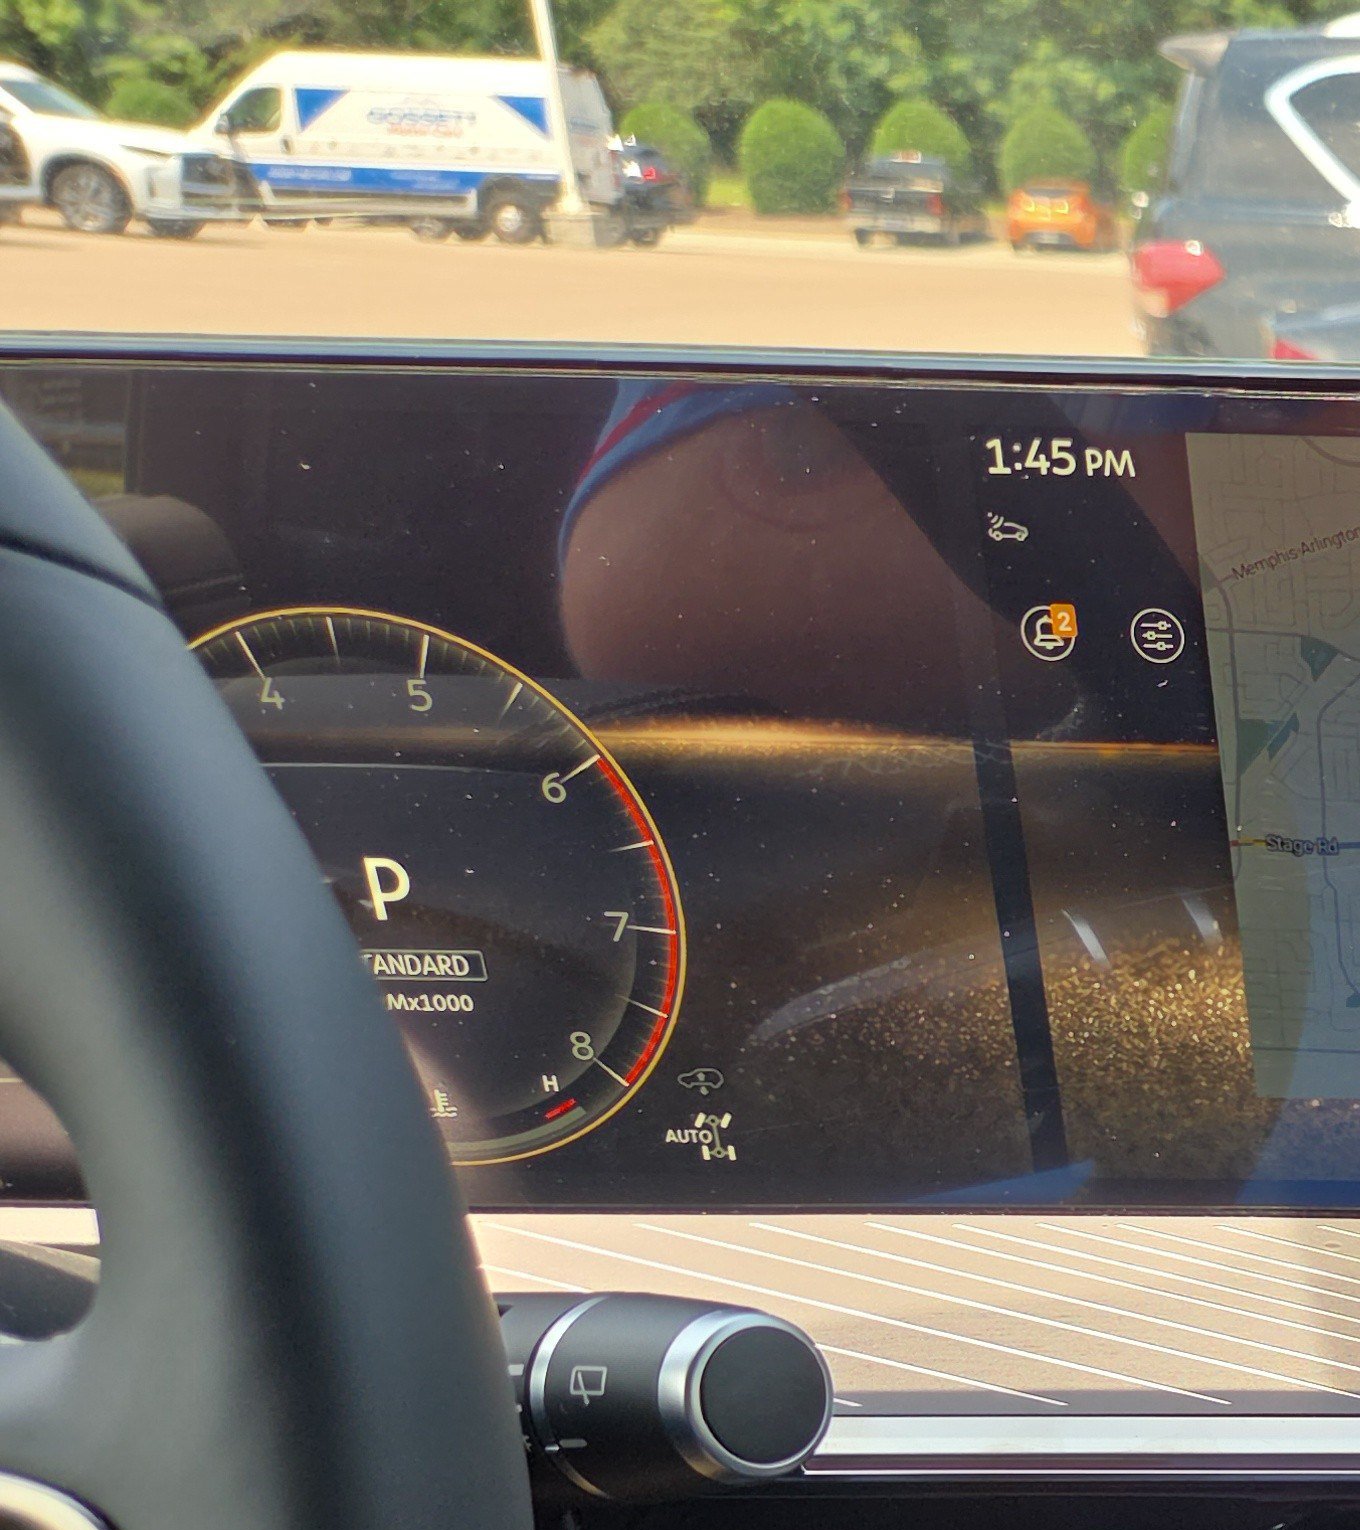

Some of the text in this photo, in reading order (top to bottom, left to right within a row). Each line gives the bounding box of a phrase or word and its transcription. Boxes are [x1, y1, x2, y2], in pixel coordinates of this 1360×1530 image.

[985, 437, 1136, 478] 1:45 PM
[1231, 546, 1299, 581] Memphis
[1056, 611, 1073, 633] 2
[259, 676, 285, 710] 4
[406, 679, 433, 712] 5
[541, 772, 567, 804] 6
[1265, 834, 1339, 857] Stage Rd
[363, 857, 410, 921] P
[603, 911, 629, 942] 7
[569, 1031, 594, 1061] 8
[542, 1074, 560, 1093] H
[665, 1128, 713, 1145] AUTO
